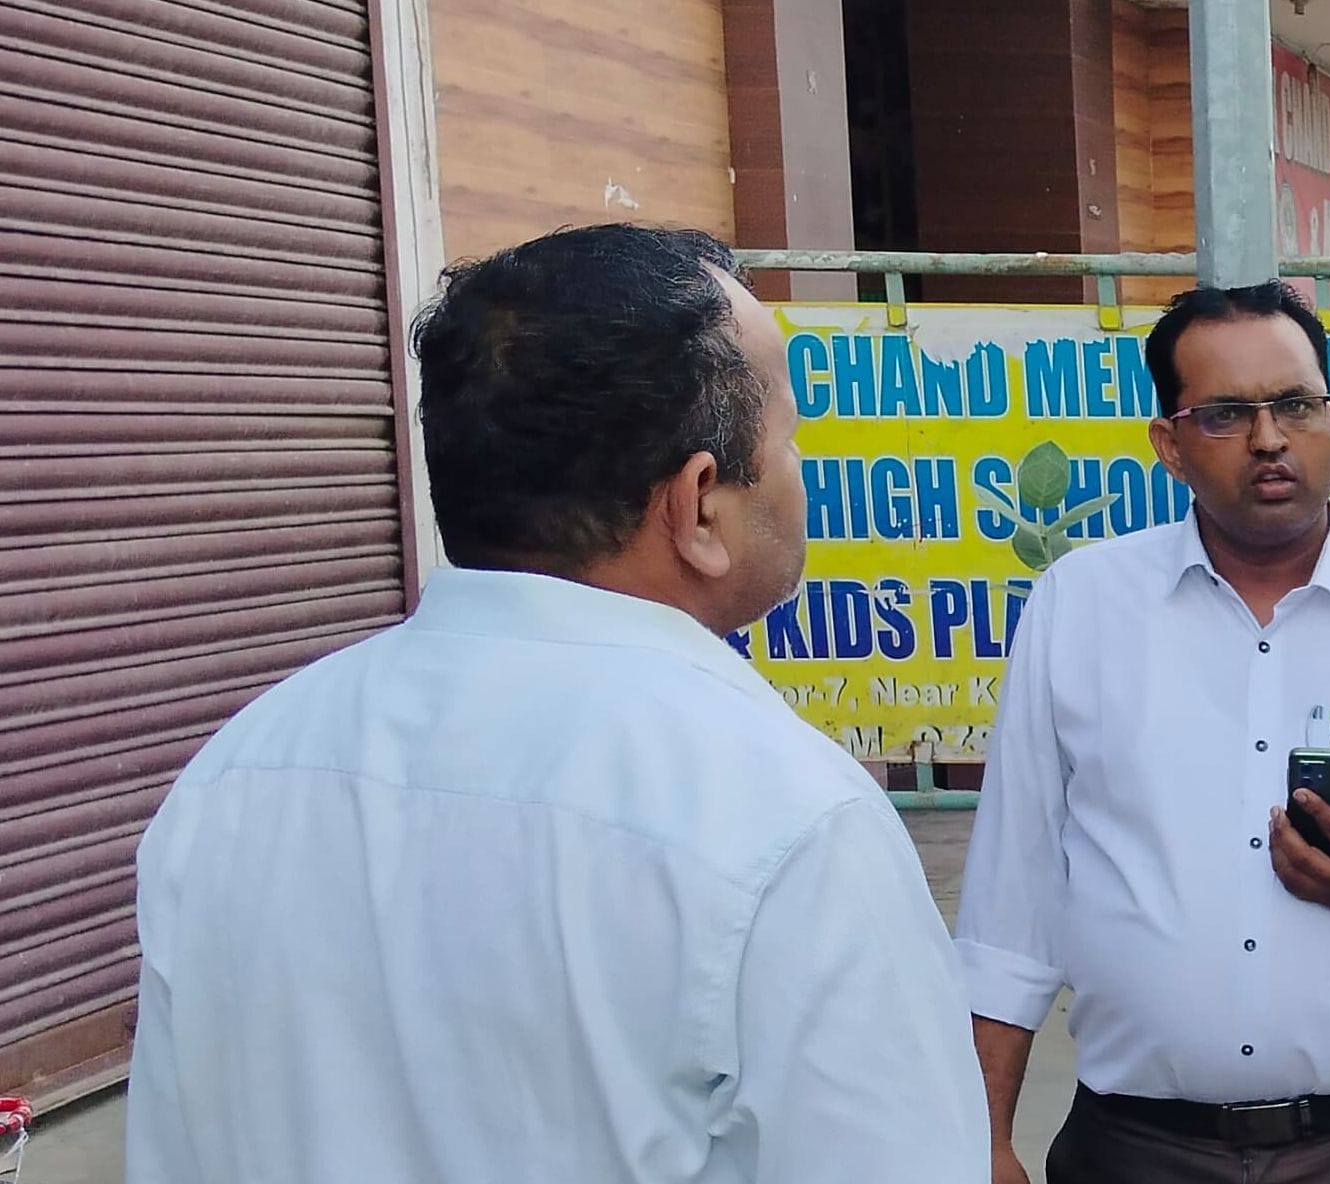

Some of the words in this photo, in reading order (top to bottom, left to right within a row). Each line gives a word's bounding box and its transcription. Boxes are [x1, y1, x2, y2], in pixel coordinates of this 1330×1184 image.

[787, 332, 1009, 420] CHAND
[801, 456, 961, 542] HIGH
[765, 578, 916, 662] KIDS
[769, 677, 859, 713] or-7,
[870, 676, 960, 708] Near
[968, 676, 998, 707] K
